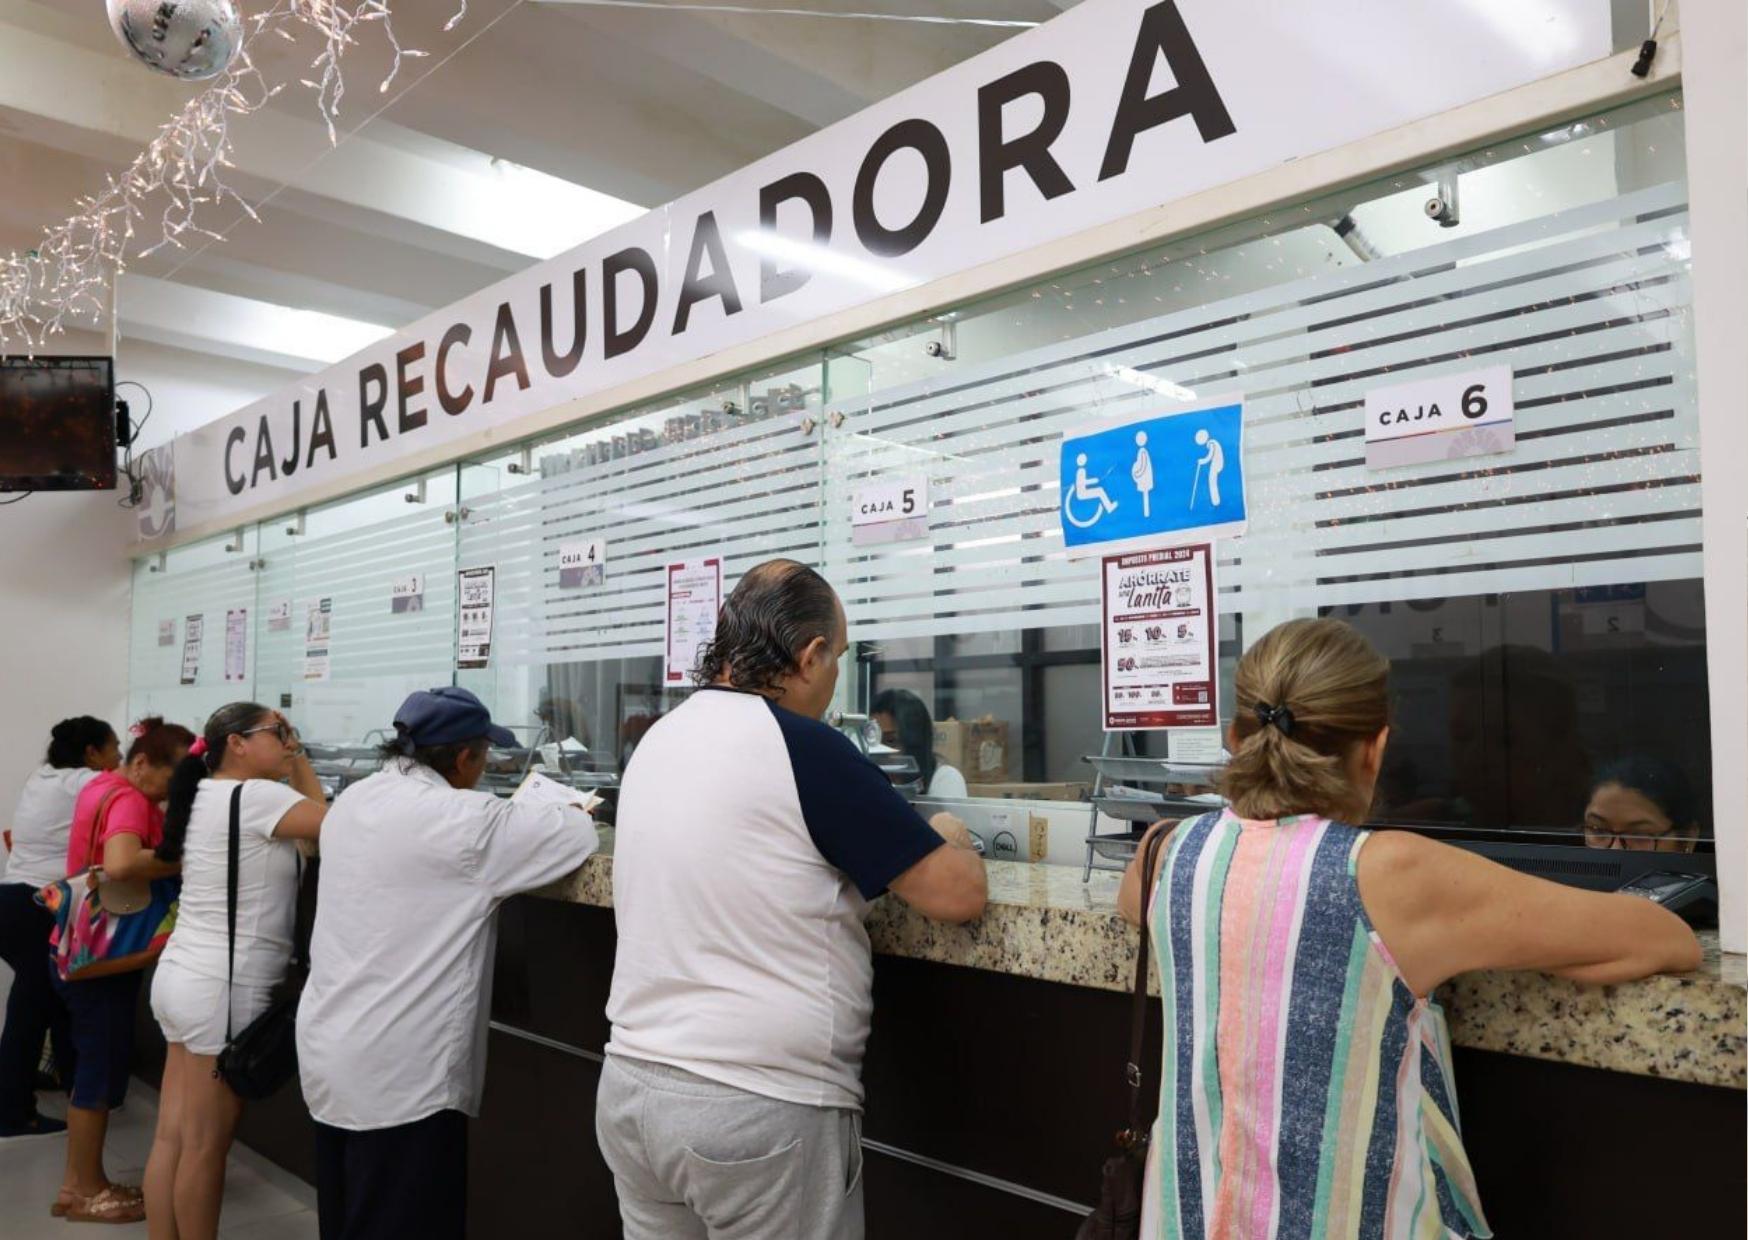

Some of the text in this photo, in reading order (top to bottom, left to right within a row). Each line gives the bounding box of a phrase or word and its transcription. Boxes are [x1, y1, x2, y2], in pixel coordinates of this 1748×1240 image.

[224, 0, 1238, 496] CAJA RECAUDADORA
[1379, 384, 1488, 426] CAJA 6
[861, 488, 915, 515] CAJA 5
[587, 543, 596, 563] 4
[995, 842, 1014, 852] DELL
